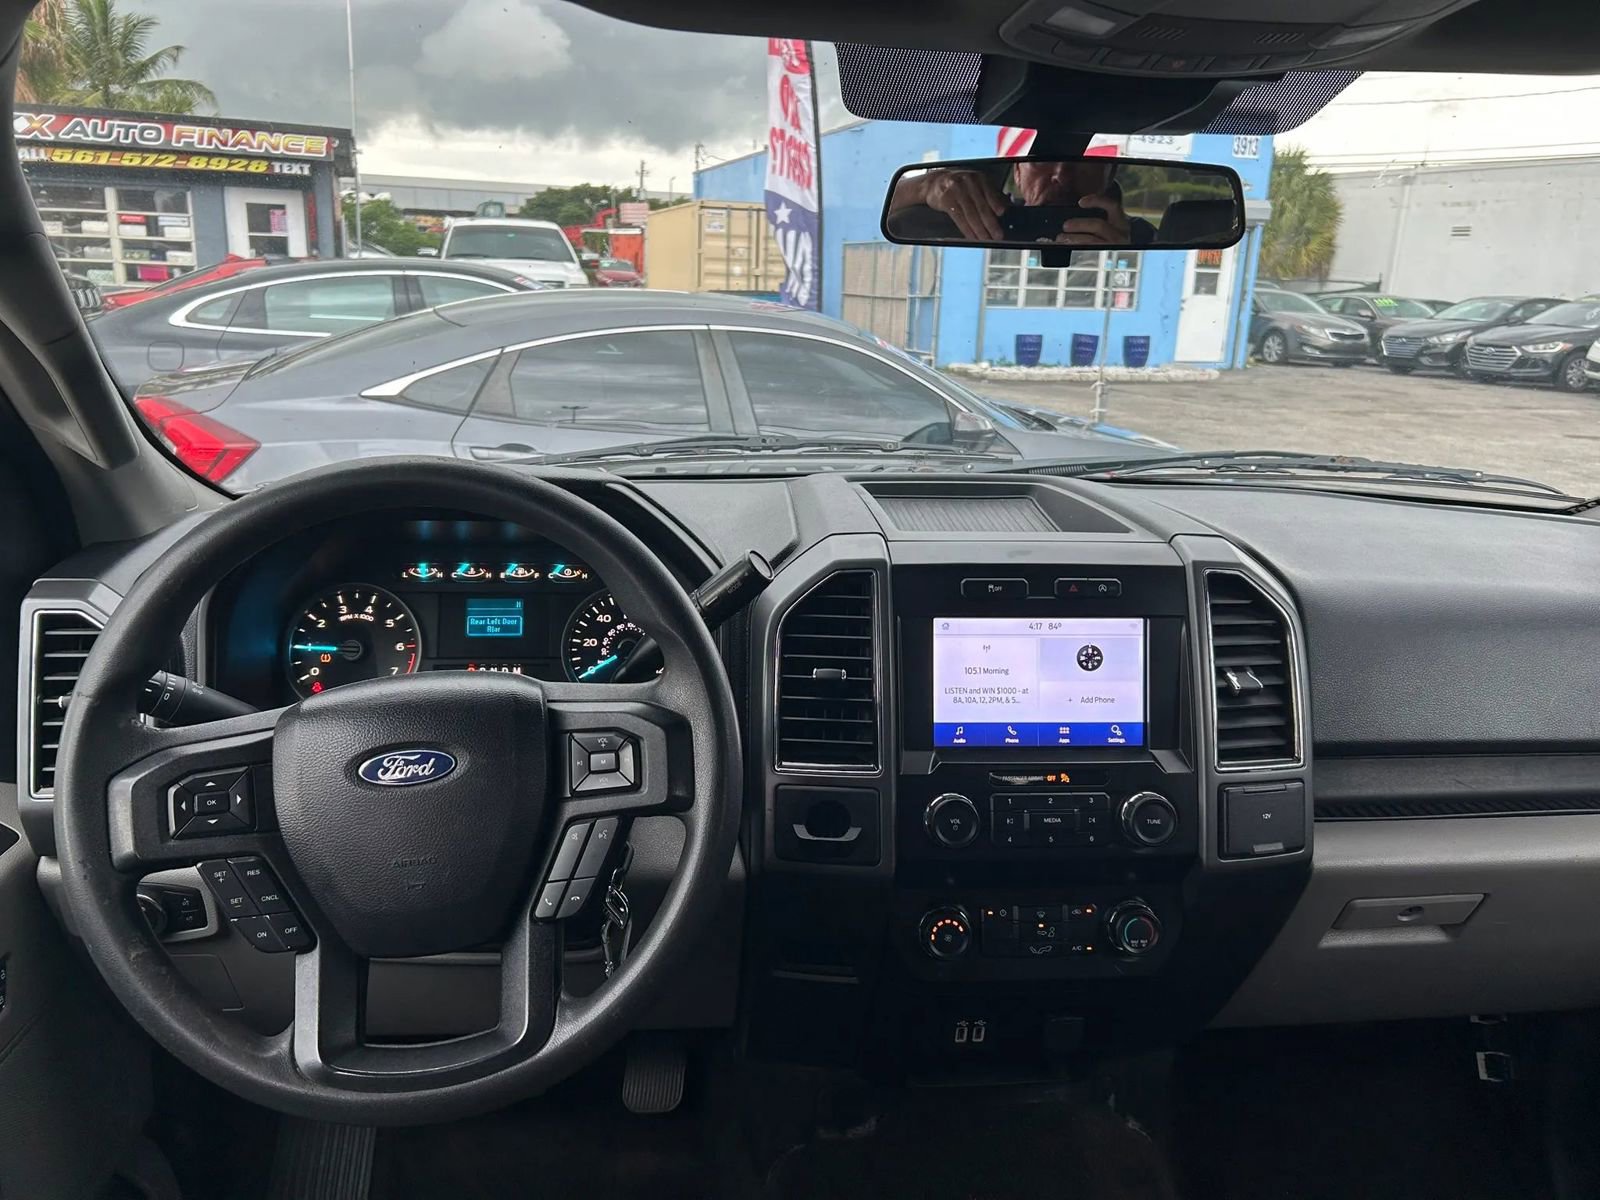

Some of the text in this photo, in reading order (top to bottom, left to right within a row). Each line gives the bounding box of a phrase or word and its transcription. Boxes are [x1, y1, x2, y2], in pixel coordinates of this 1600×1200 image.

[59, 118, 165, 144] AUTO
[172, 125, 328, 157] FINANCE
[1233, 136, 1259, 156] 3913
[51, 148, 269, 172] 561-572-8928
[271, 162, 311, 175] TEXT
[340, 606, 347, 614] 3
[365, 606, 373, 614] 4
[596, 614, 612, 622] 40
[317, 620, 326, 628] 2
[385, 620, 394, 628] 5
[395, 642, 404, 651] 6
[583, 638, 597, 647] 20
[310, 667, 320, 676] 0
[390, 667, 399, 676] 7
[983, 667, 1009, 675] Morning
[377, 754, 436, 780] Ford
[393, 856, 438, 868] AIRBAG
[261, 894, 279, 902] CNCL
